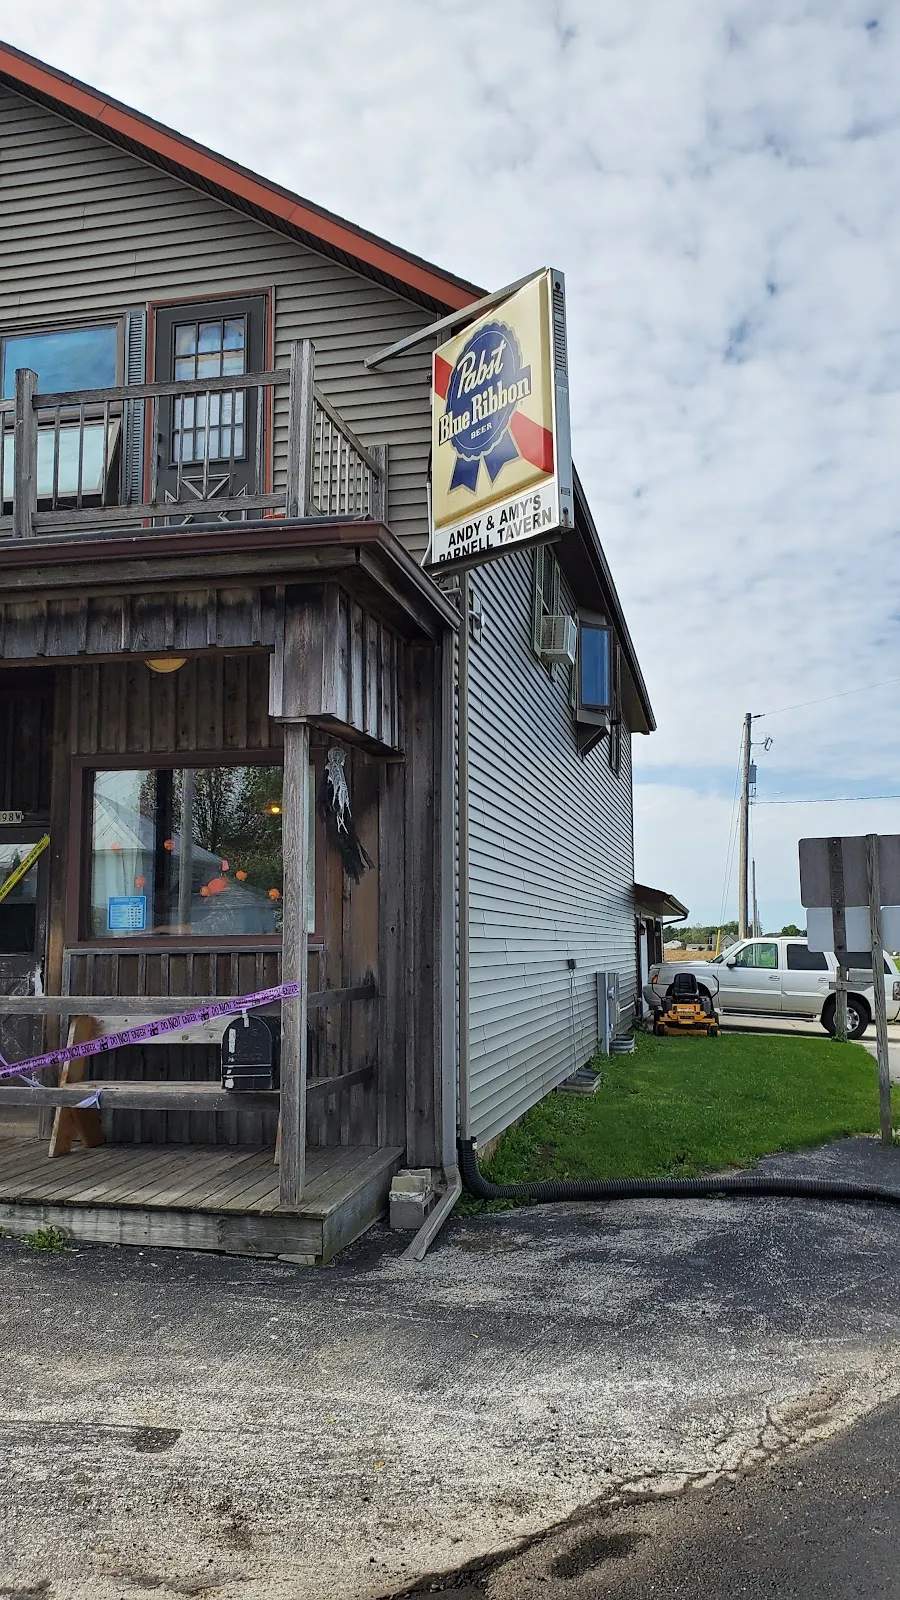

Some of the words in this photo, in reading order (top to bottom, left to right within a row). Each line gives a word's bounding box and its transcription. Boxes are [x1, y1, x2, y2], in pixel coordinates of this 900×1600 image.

[457, 339, 507, 399] Pabst
[439, 410, 470, 445] Blue
[471, 377, 530, 425] Ribbon
[470, 422, 493, 440] BEER
[448, 520, 482, 548] ANDY
[486, 515, 495, 531] &
[499, 494, 541, 526] AMY'S
[497, 507, 552, 543] TAVERN
[168, 1015, 181, 1030] NOT
[181, 1013, 197, 1025] ENTER
